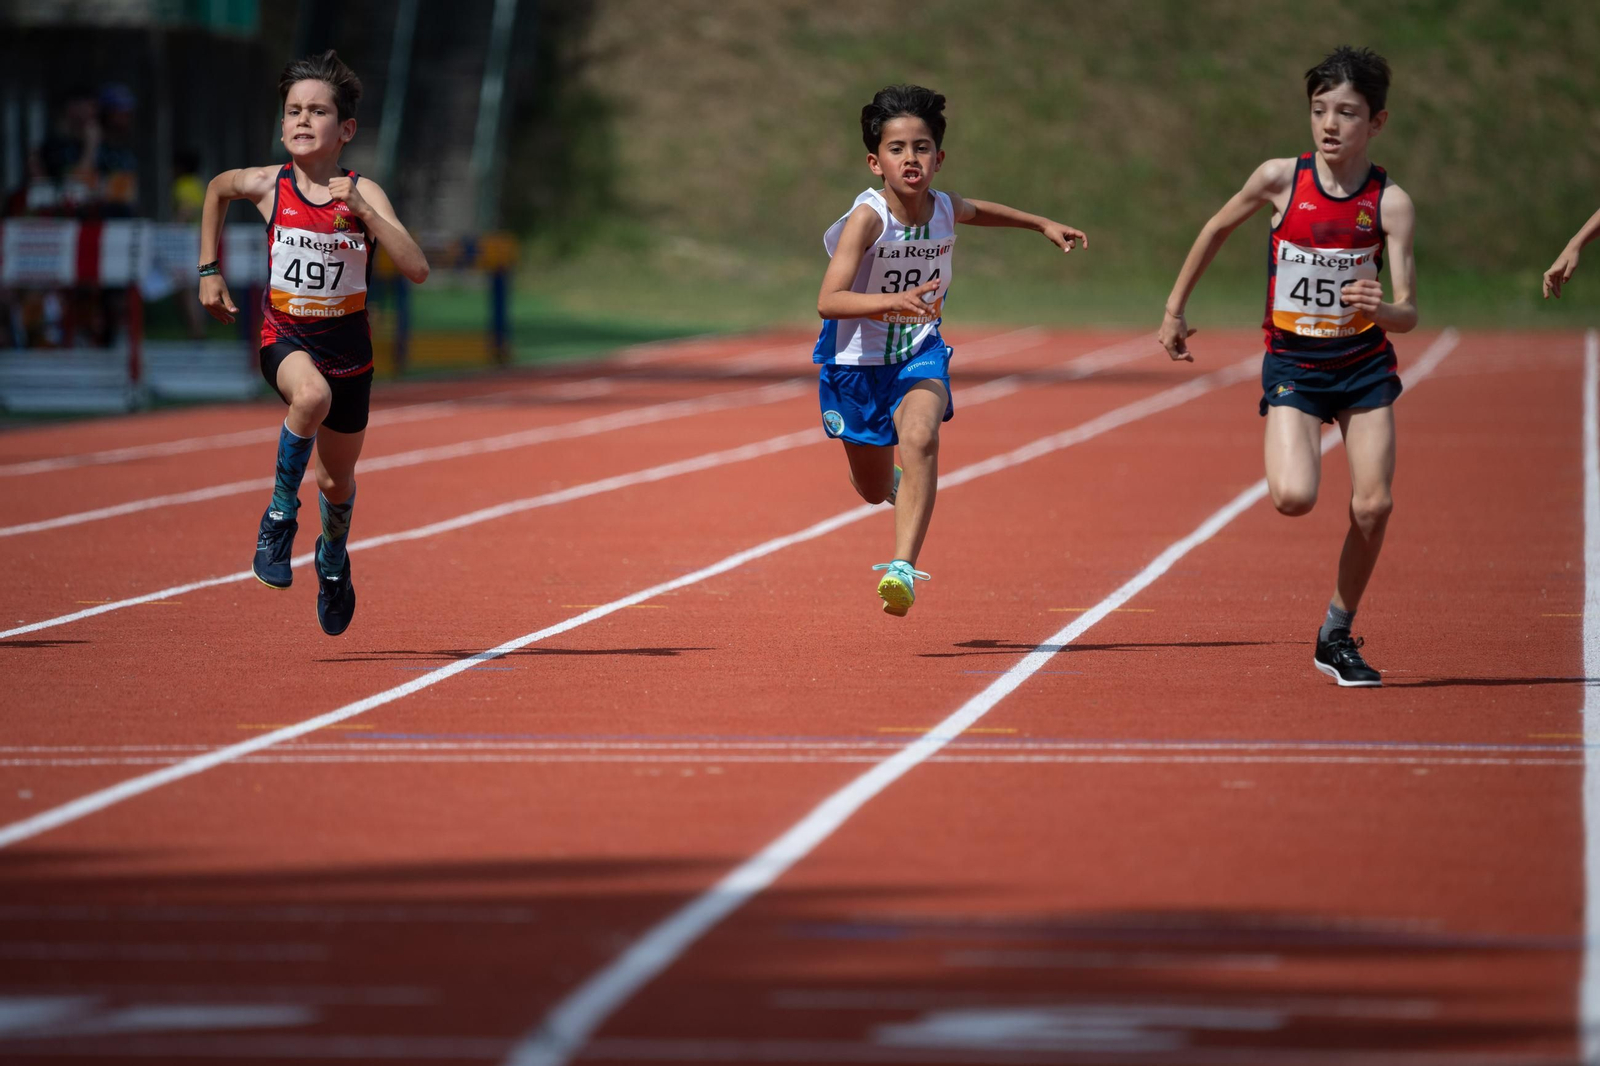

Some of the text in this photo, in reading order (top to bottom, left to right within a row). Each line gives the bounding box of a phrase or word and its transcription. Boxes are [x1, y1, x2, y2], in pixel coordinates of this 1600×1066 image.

[276, 230, 294, 246] La
[877, 246, 900, 259] La
[1281, 247, 1306, 264] La
[283, 258, 345, 290] 497
[288, 305, 345, 317] telemiño
[1294, 325, 1356, 337] telemiño
